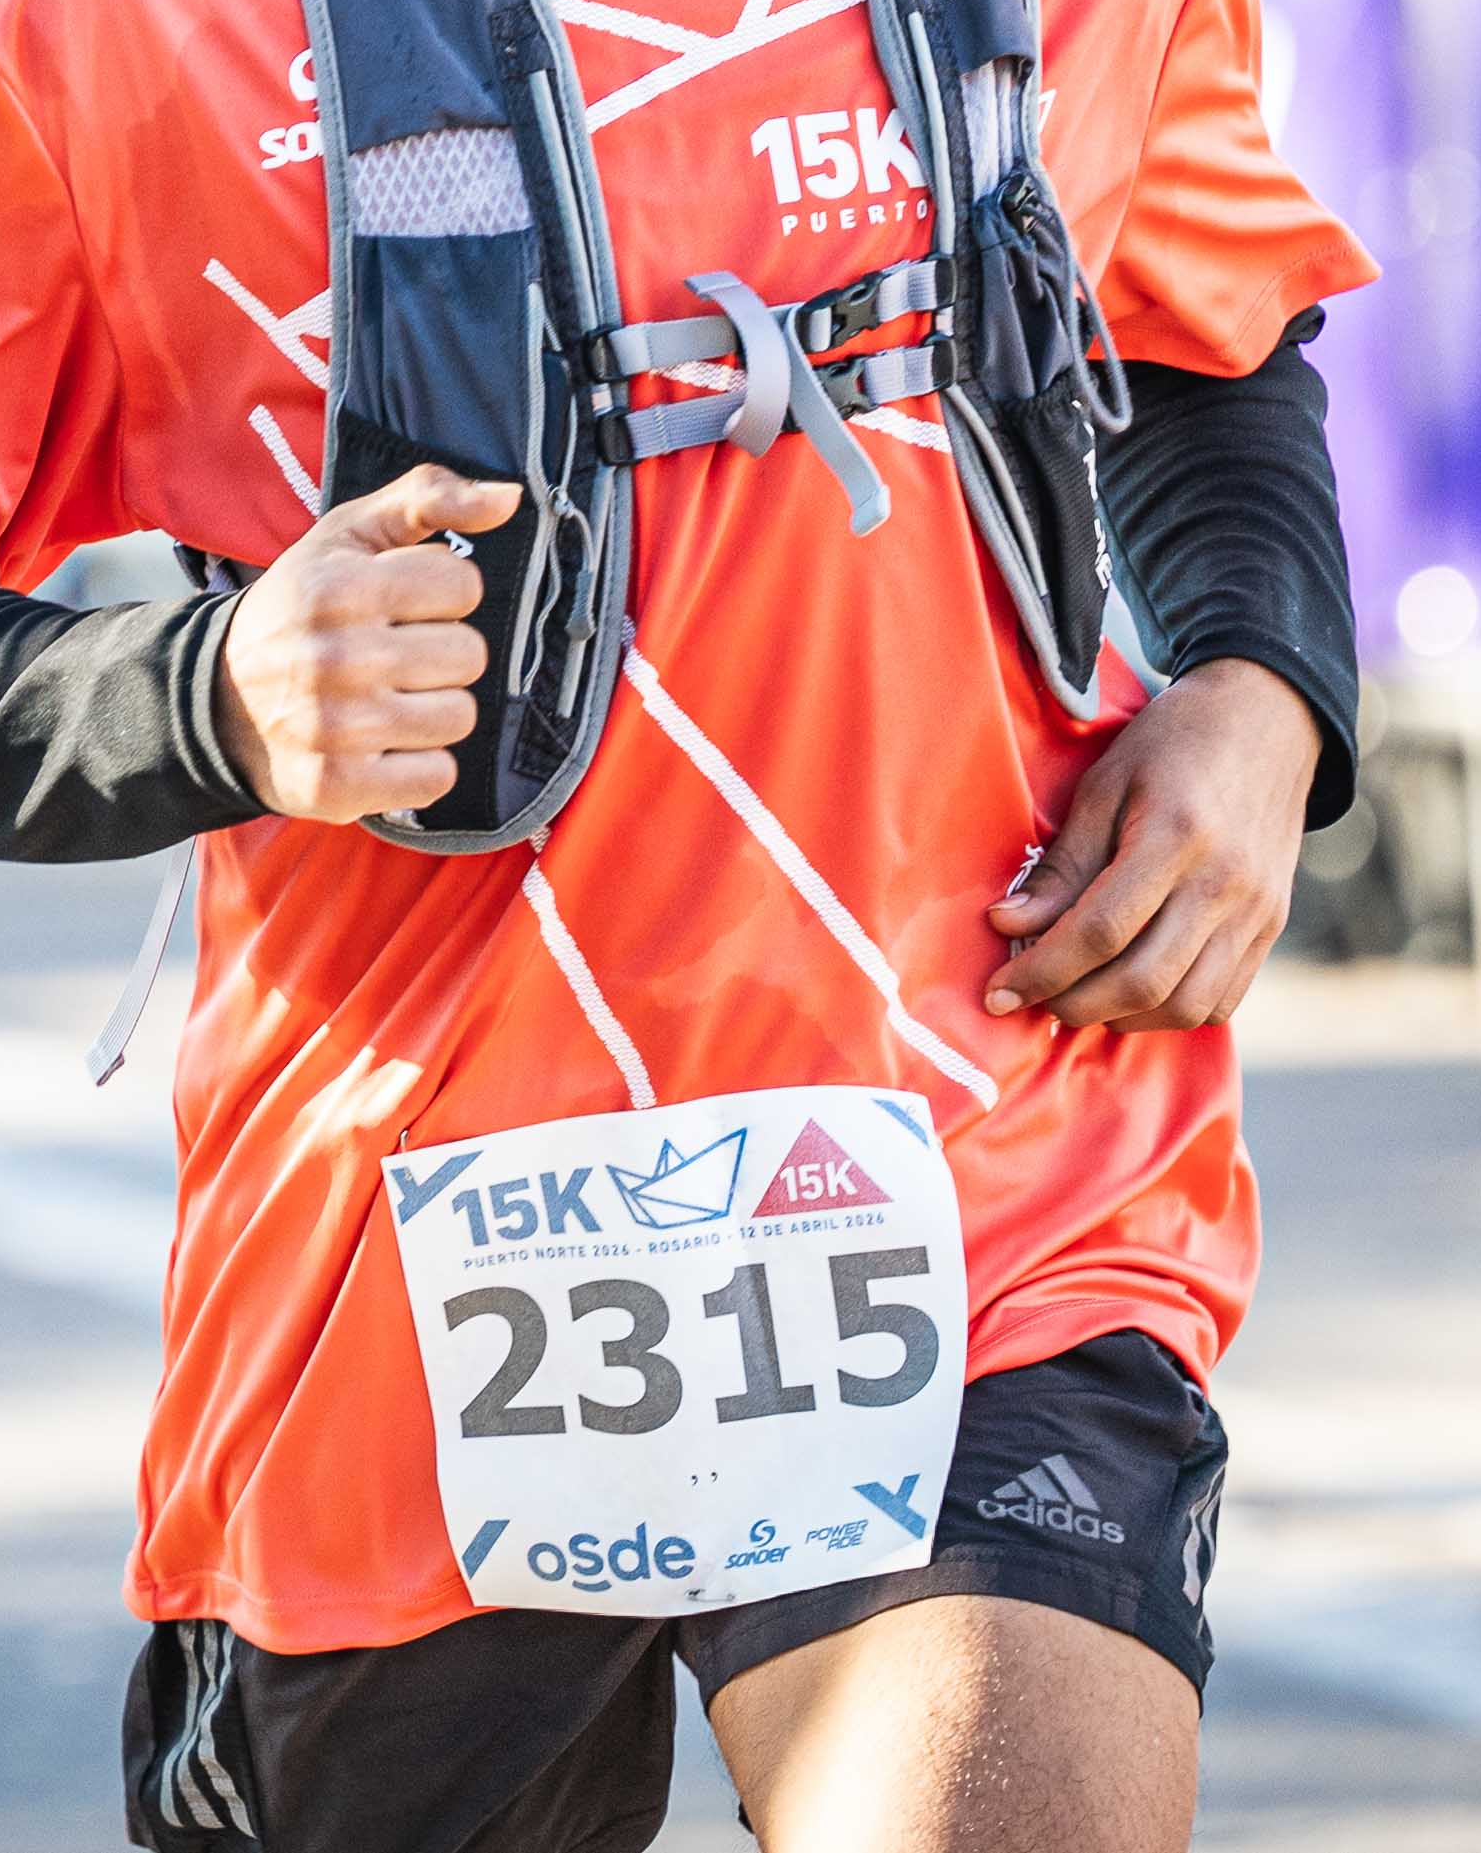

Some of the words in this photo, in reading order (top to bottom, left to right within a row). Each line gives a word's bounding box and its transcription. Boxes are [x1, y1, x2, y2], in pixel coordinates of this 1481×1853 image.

[750, 107, 928, 204] 15K
[780, 199, 928, 237] PUERTO
[452, 1167, 602, 1247] 15K
[779, 1159, 859, 1203] 15K
[463, 1249, 529, 1270] PUERTO
[536, 1243, 587, 1260] NORTE
[593, 1242, 629, 1256] 2026
[648, 1232, 722, 1255] ROSARIO
[739, 1225, 756, 1239] 12
[764, 1222, 783, 1237] DE
[790, 1217, 839, 1234] ABRIL
[846, 1212, 885, 1228] 2026
[442, 1245, 940, 1439] 2315
[804, 1518, 869, 1545] POWER
[977, 1499, 1125, 1544] adidas
[527, 1521, 696, 1586] osde
